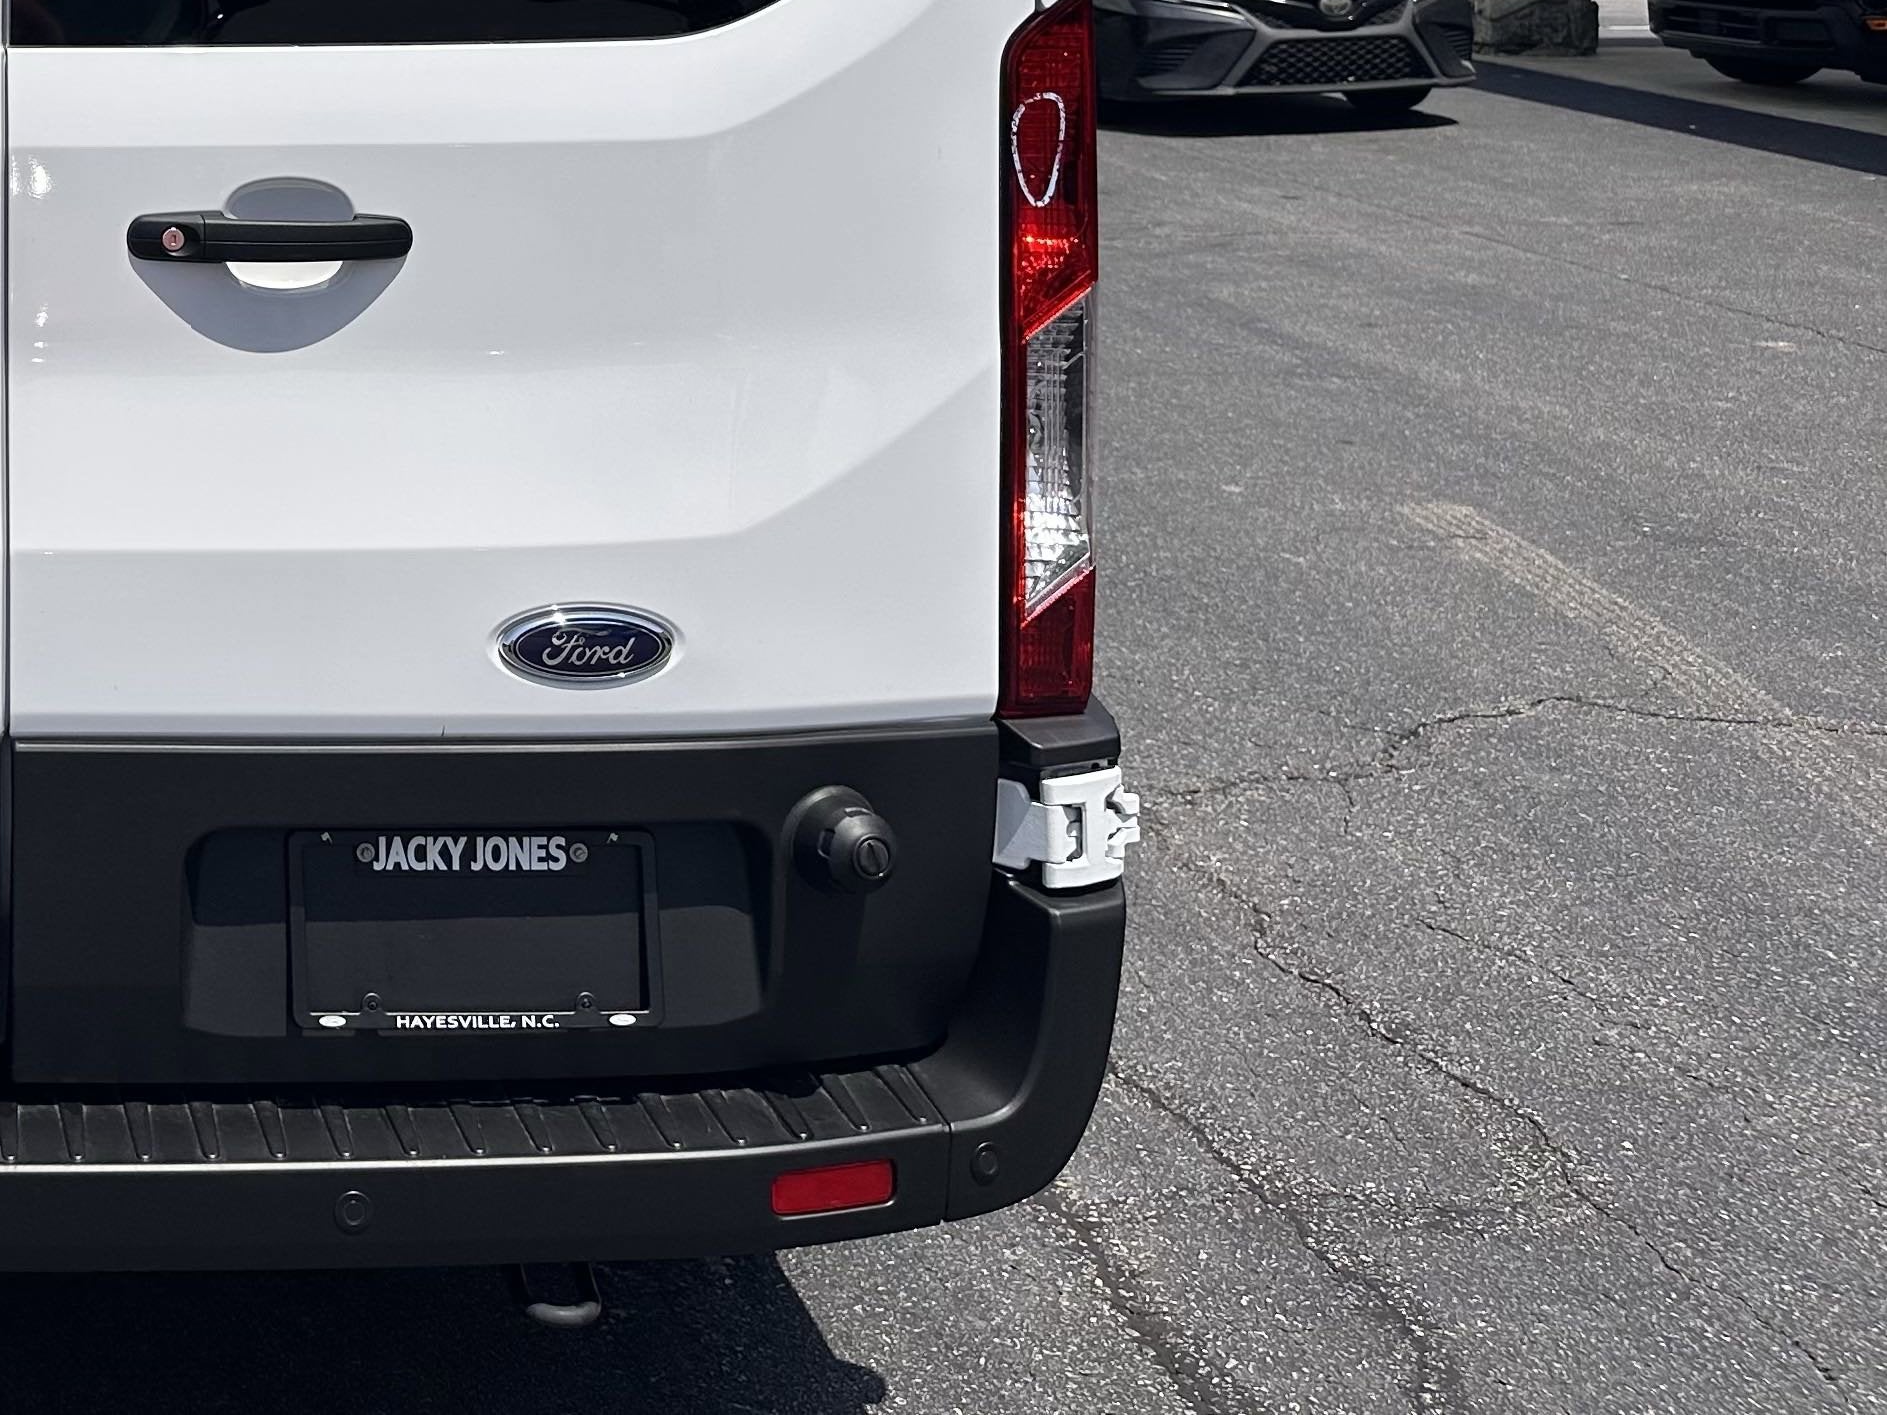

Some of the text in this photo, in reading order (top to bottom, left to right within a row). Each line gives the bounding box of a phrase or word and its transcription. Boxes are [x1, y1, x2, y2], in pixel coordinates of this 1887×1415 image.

[541, 627, 637, 666] Ford
[373, 835, 567, 872] JACKY JONES
[396, 1014, 560, 1030] HAYESVILLE, N.C.
